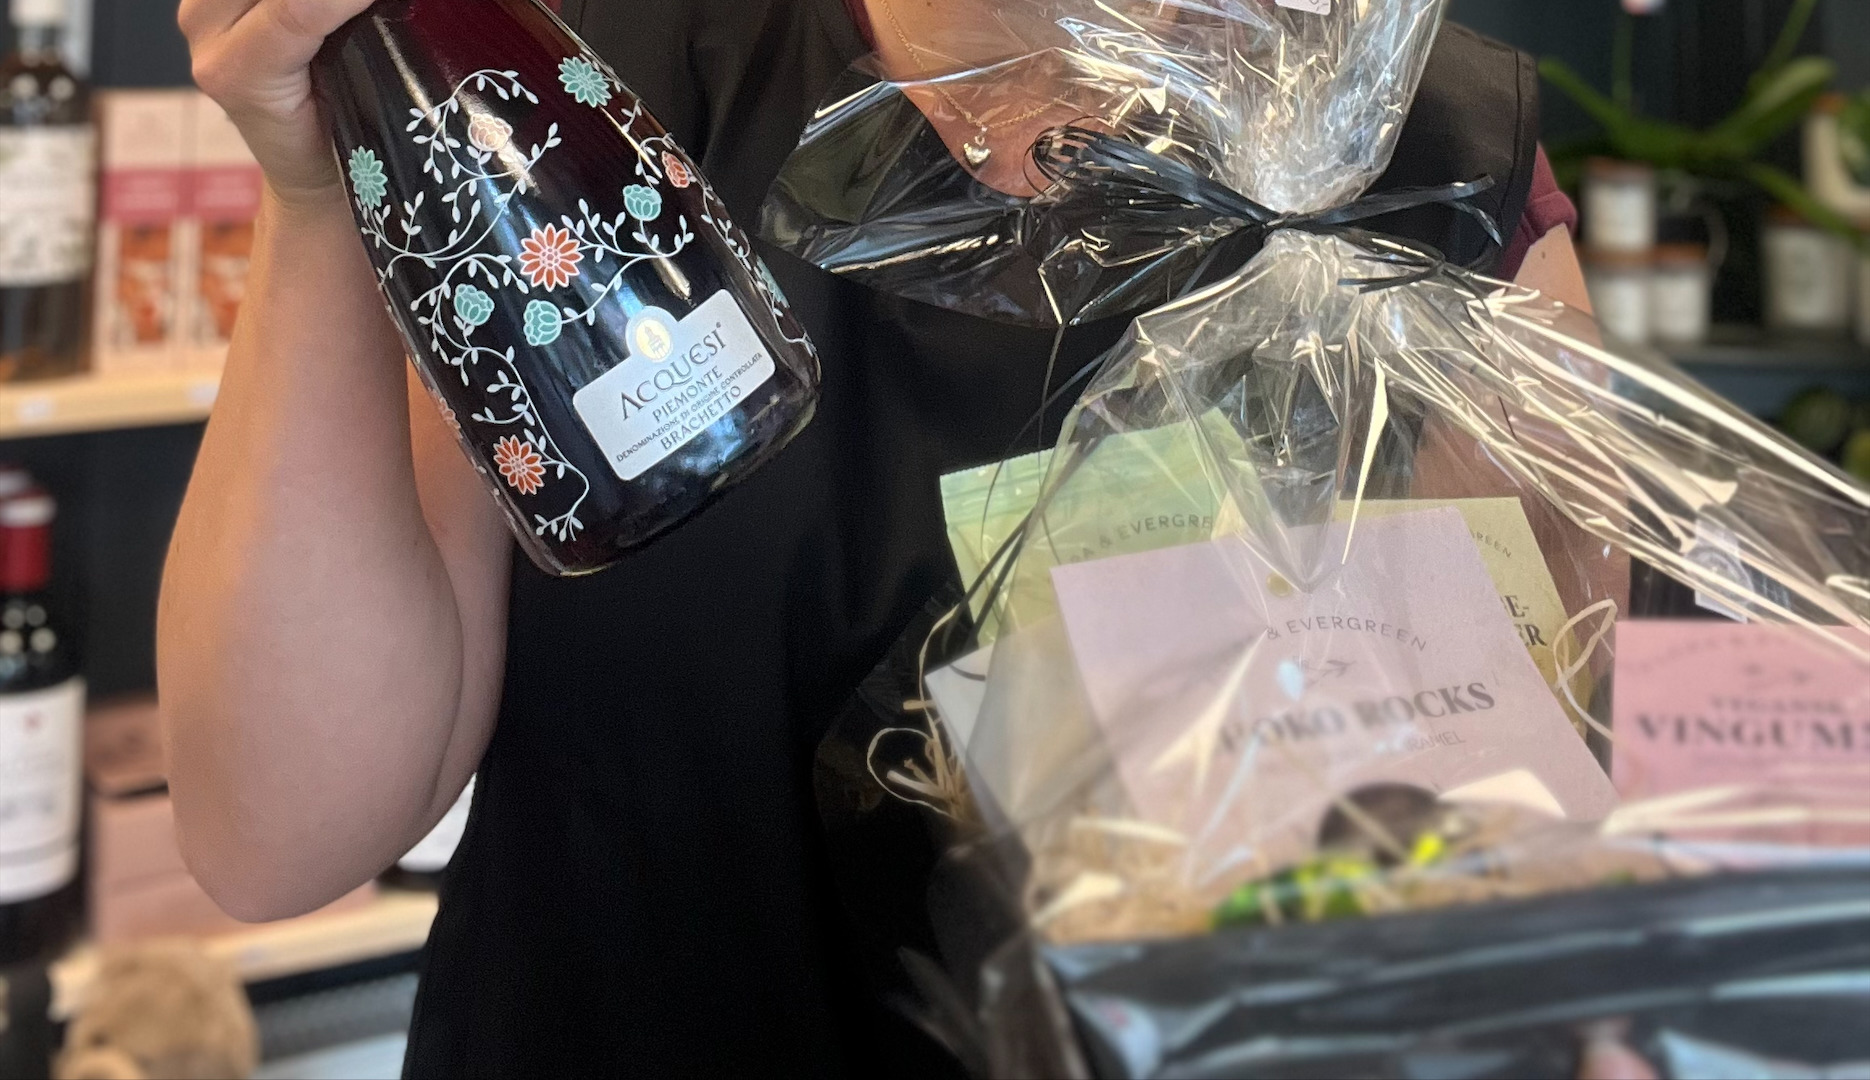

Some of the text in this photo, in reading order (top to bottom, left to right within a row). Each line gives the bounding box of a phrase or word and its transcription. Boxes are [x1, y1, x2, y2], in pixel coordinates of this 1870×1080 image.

[620, 328, 727, 420] ACQUESI
[652, 366, 723, 423] PIEMONTE
[616, 352, 763, 462] DENOMINAZIONE DI ORIGINE CONTROLLATA
[660, 385, 742, 451] BRACHETTO
[1116, 514, 1214, 541] EVERGRE
[1286, 616, 1427, 651] EVERGREEN
